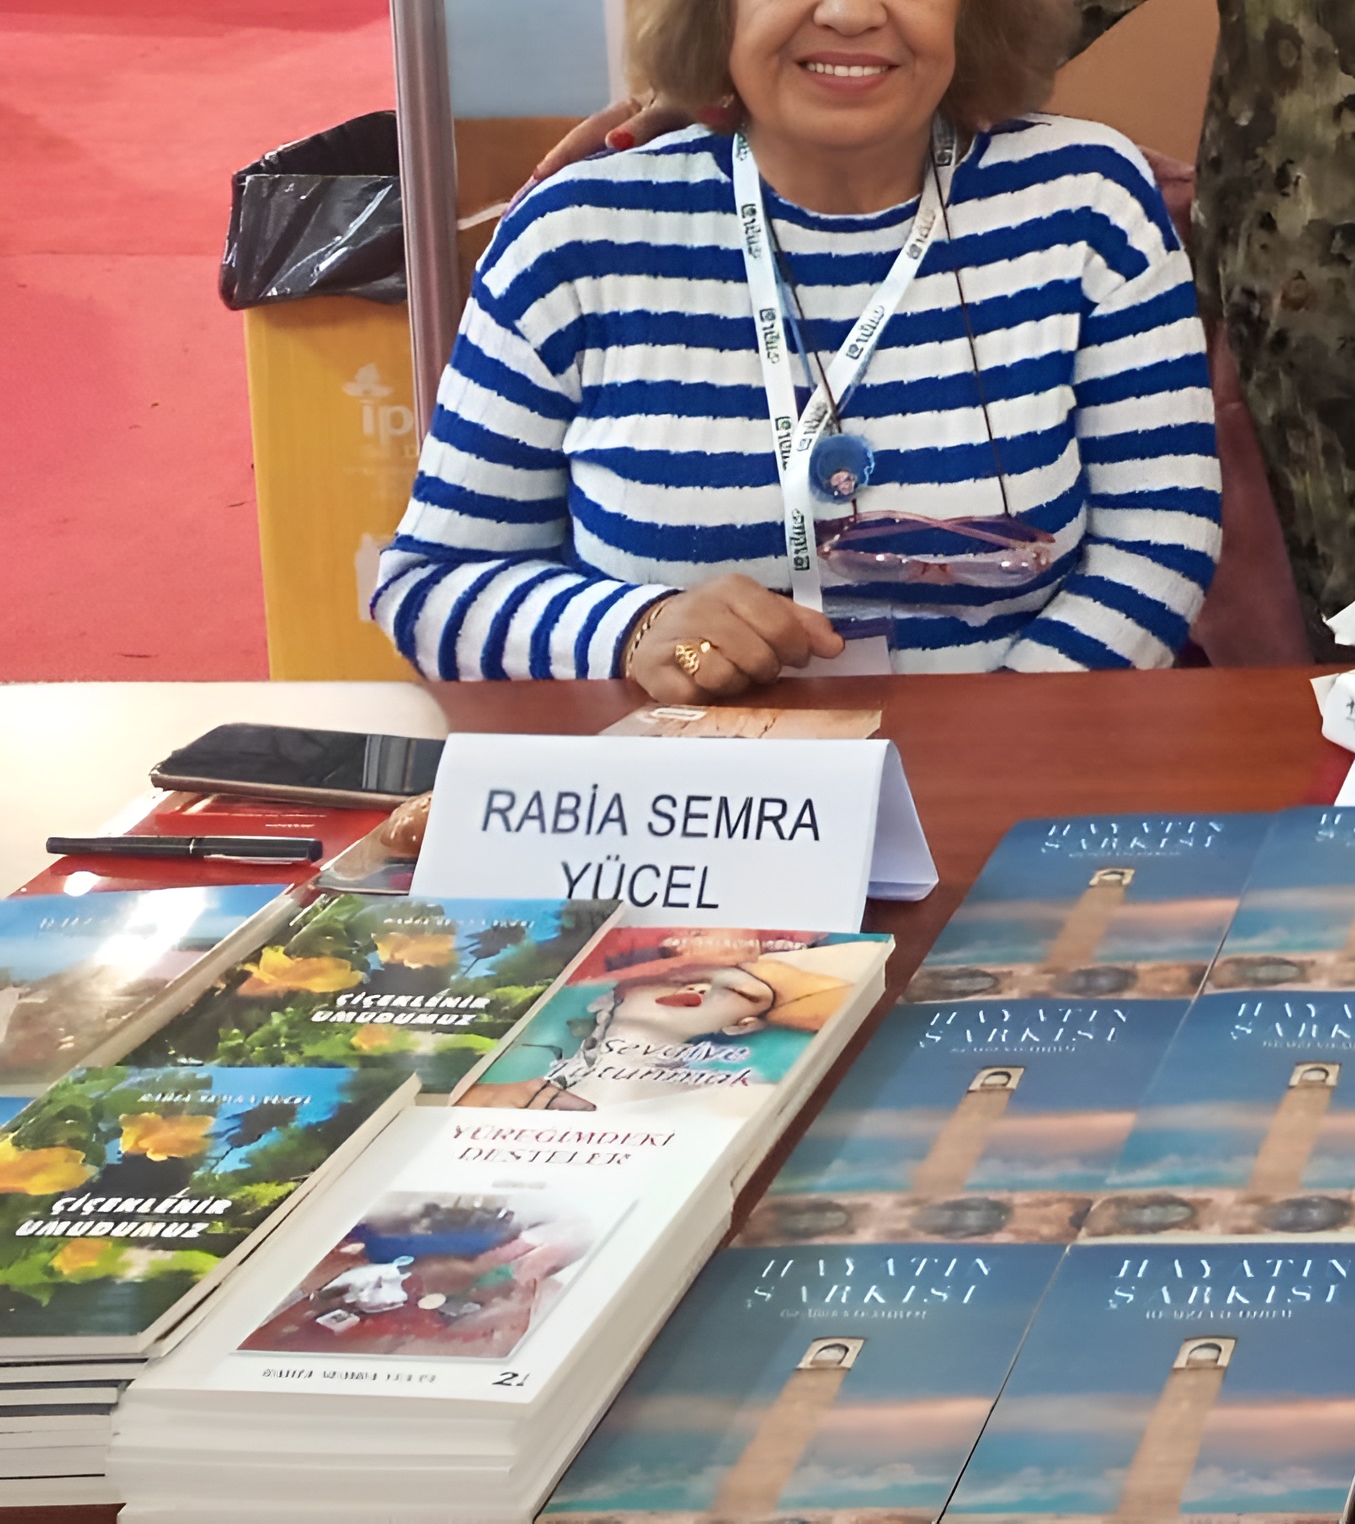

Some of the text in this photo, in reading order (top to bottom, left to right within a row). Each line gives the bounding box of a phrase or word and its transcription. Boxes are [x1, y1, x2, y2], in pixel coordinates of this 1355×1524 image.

[481, 783, 821, 842] RABİA SEMRA
[560, 854, 720, 909] YÜCEL
[310, 1010, 477, 1026] UMUDUMUZ
[15, 1220, 209, 1238] UMUDUMUZ
